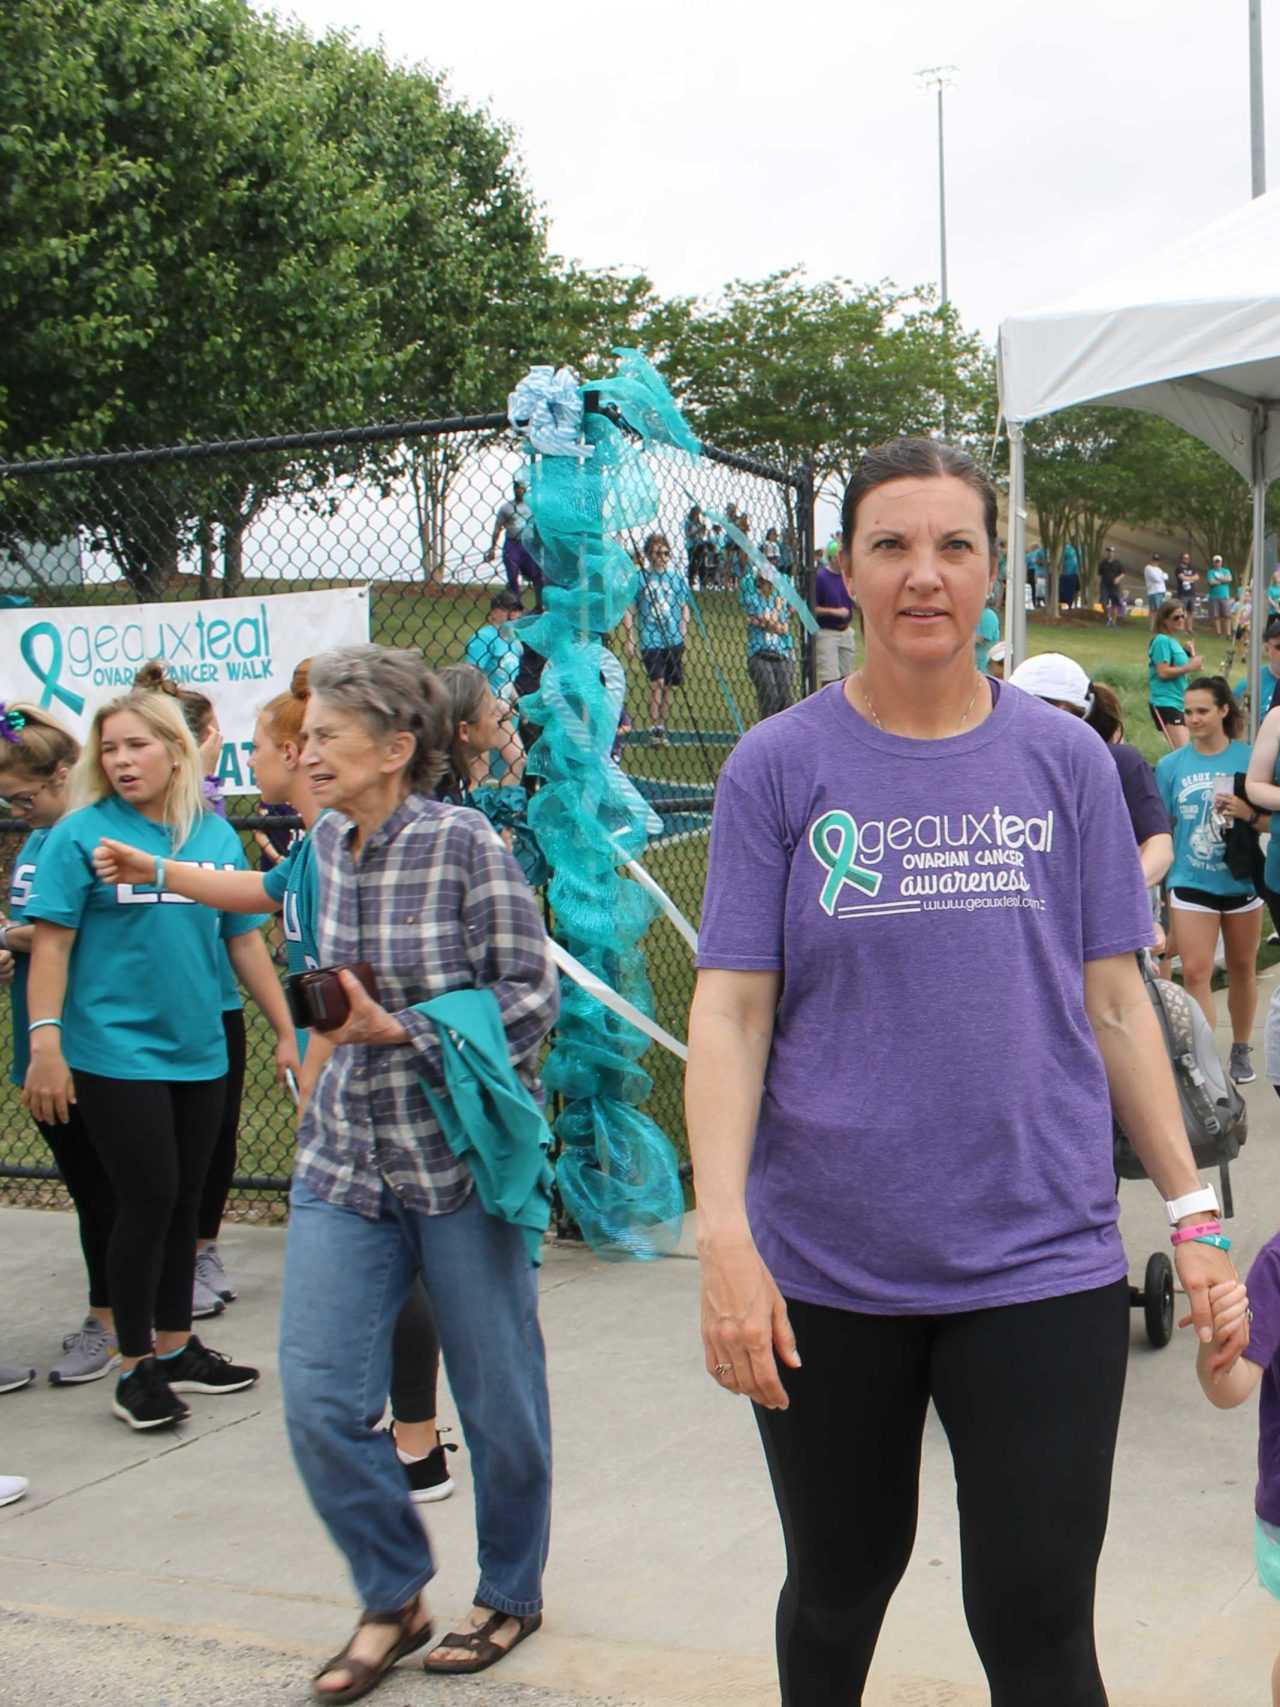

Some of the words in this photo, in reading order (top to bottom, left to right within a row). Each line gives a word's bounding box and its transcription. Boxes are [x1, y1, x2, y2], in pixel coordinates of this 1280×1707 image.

[164, 663, 219, 684] ANCER
[226, 659, 273, 681] WALK
[858, 805, 1054, 865] geauxteal
[902, 851, 970, 870] OVARIAN
[974, 848, 1025, 868] CANCER
[900, 870, 1031, 897] awareness
